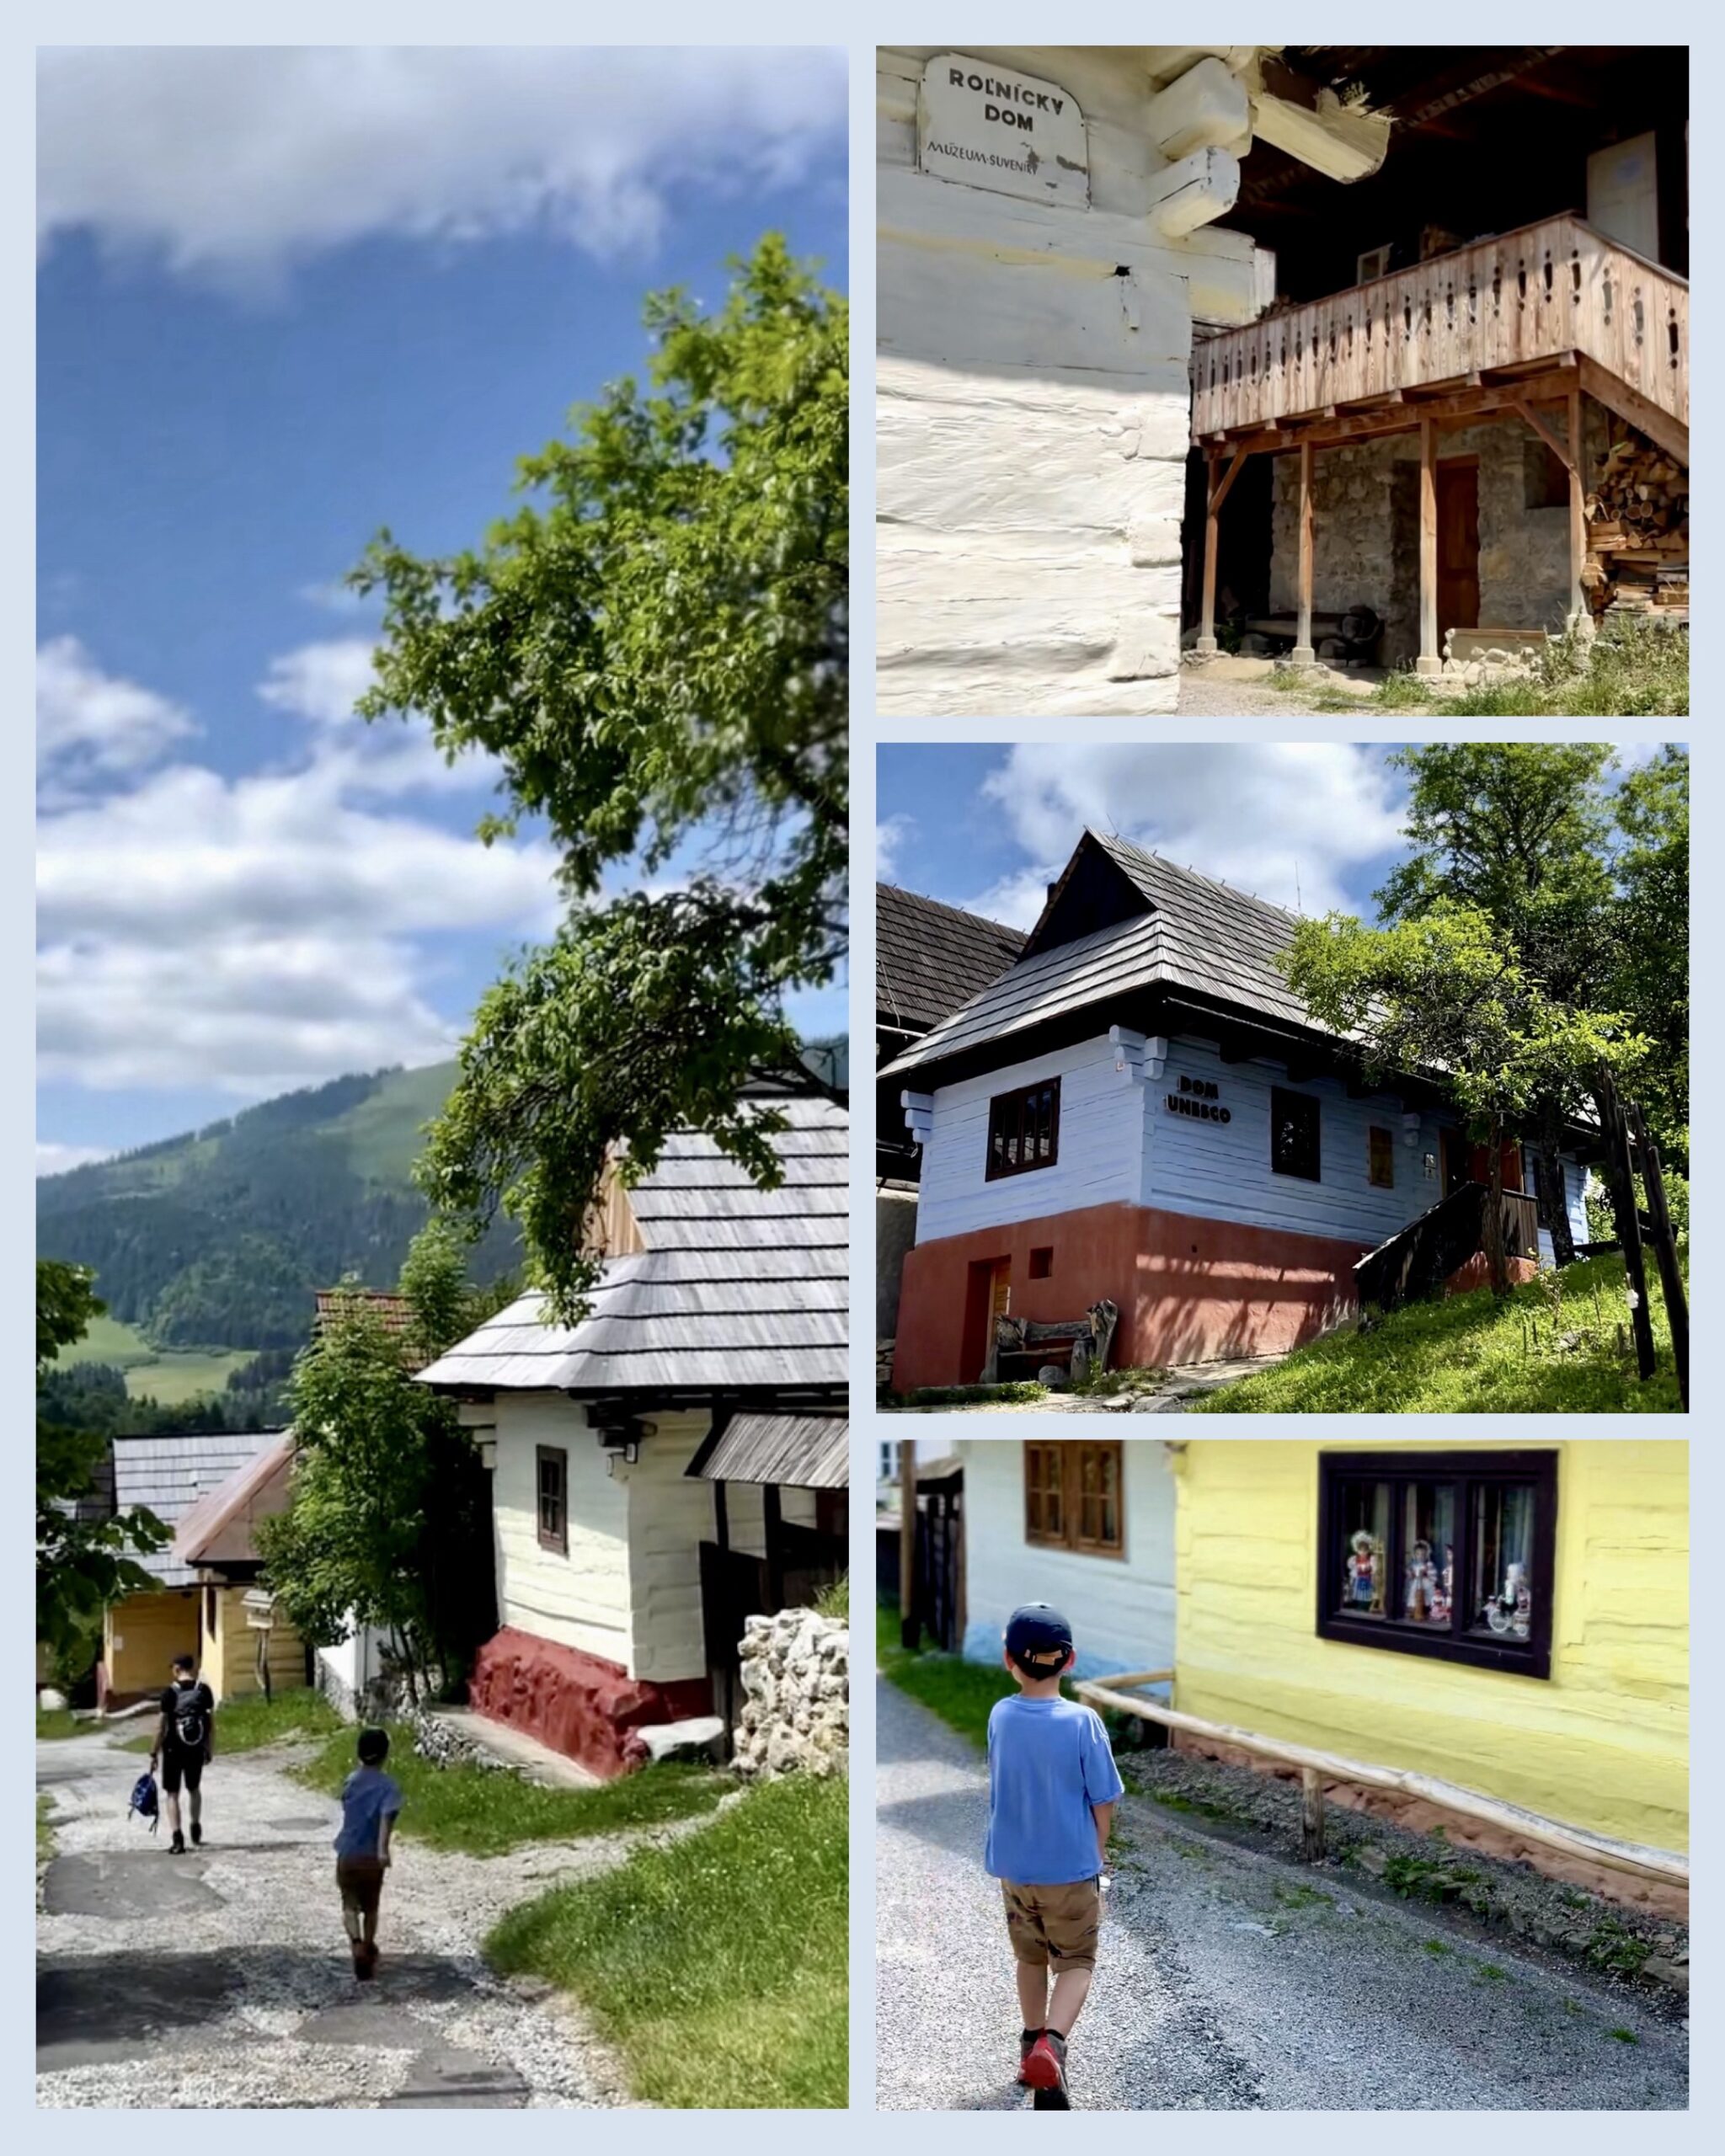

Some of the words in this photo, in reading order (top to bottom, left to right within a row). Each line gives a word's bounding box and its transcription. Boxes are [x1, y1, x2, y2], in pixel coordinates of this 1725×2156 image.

[949, 68, 1063, 115] ROĽNÍCKY
[985, 104, 1033, 131] DOM
[1178, 1075, 1219, 1100] DOM
[1166, 1094, 1231, 1123] UNESCO
